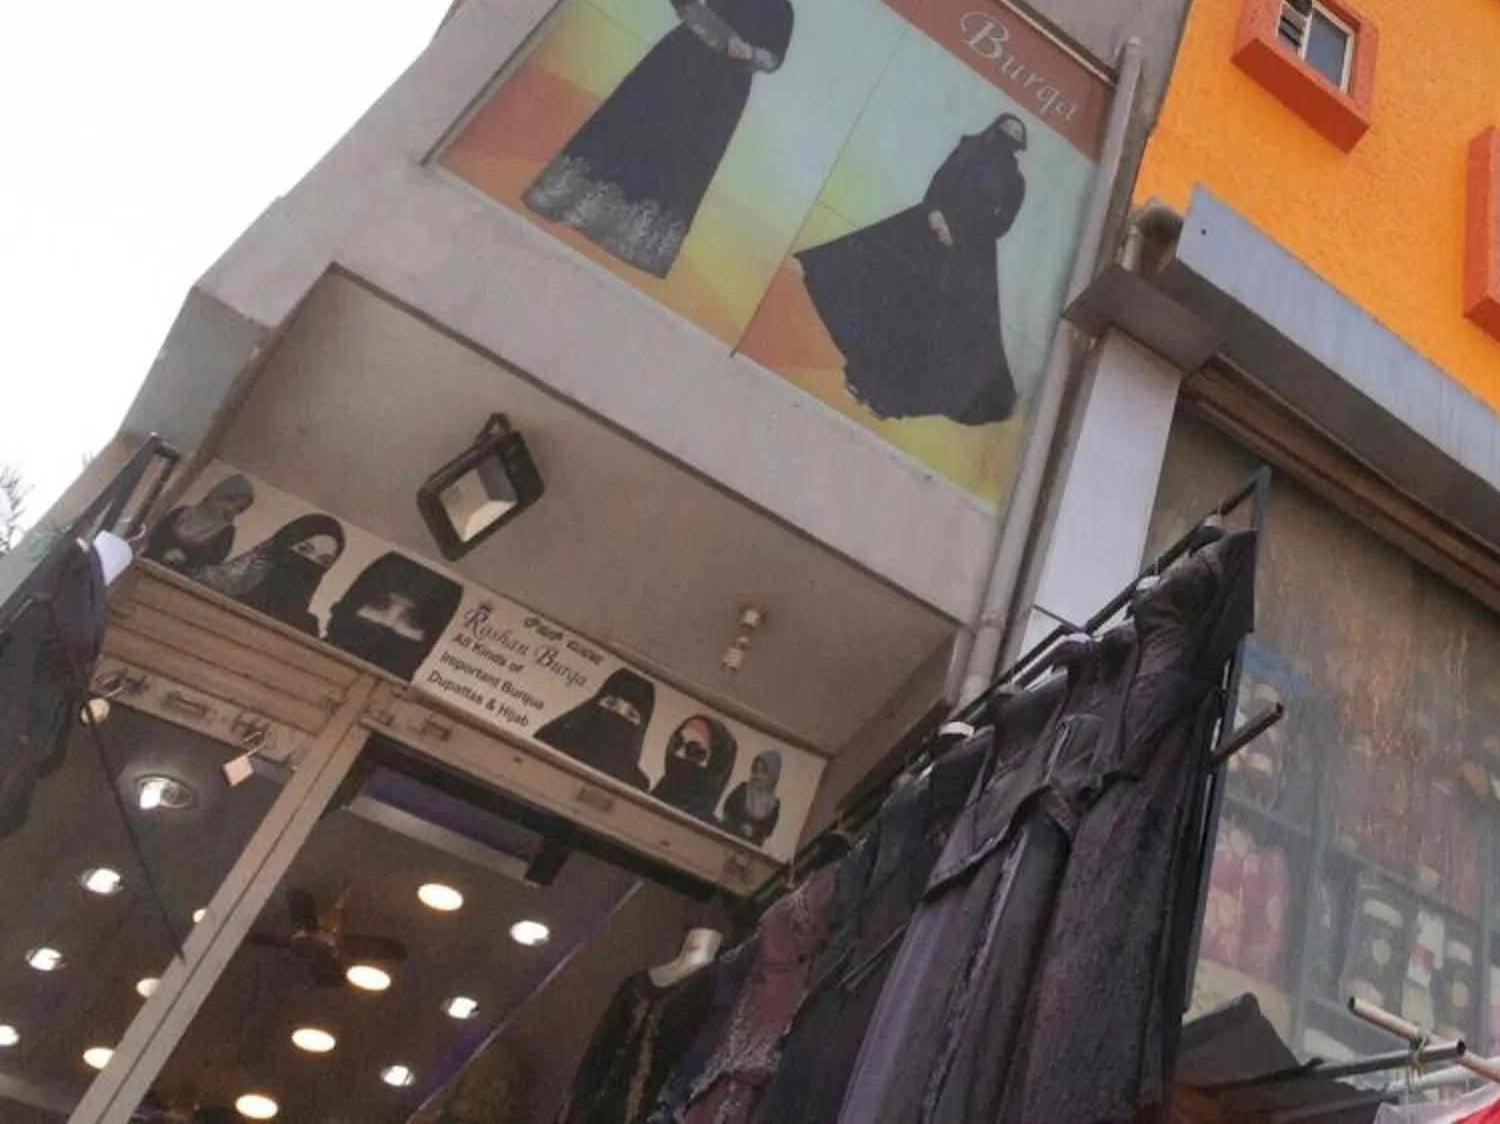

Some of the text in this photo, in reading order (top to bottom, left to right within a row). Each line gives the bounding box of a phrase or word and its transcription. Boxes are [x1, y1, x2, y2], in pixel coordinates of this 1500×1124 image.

[960, 11, 1080, 122] Burqa
[463, 606, 530, 656] Roshan
[473, 639, 507, 667] Kinds
[509, 661, 525, 674] of
[485, 698, 498, 711] &
[499, 703, 529, 726] Hijab
